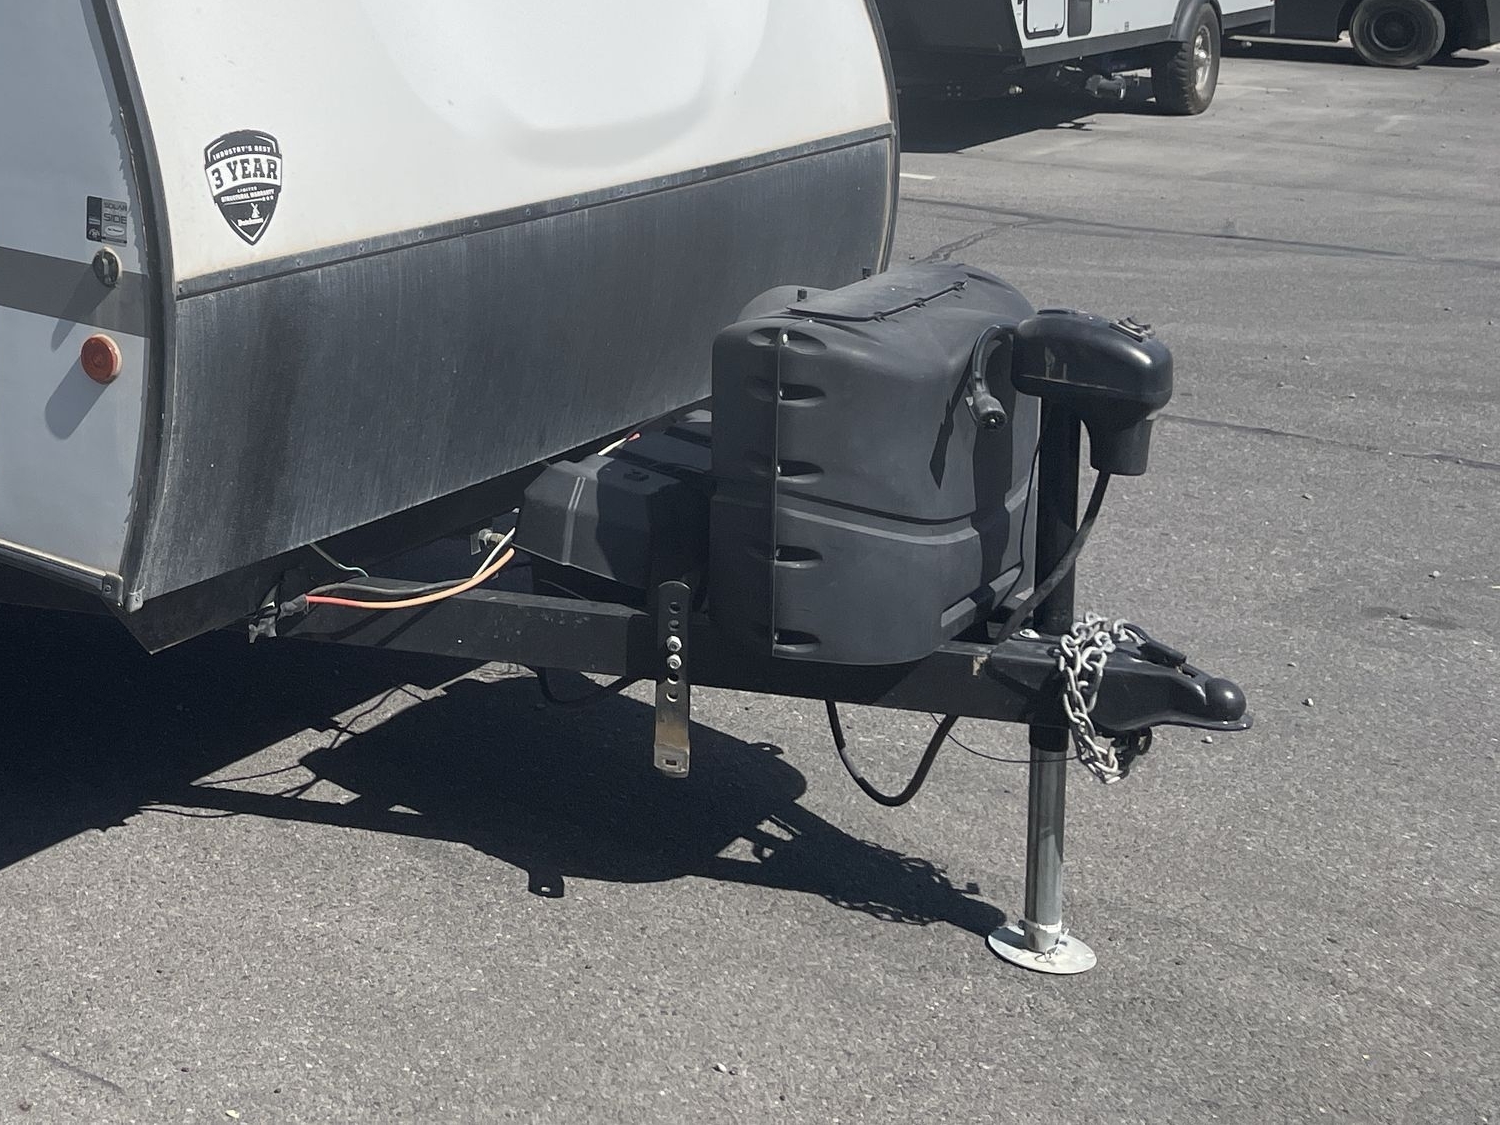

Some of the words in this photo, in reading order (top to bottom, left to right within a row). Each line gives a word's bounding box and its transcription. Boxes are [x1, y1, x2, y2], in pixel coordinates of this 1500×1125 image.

[254, 145, 271, 153] BEST
[211, 167, 224, 189] 3
[226, 158, 278, 181] YEAR
[103, 212, 127, 225] SIDE
